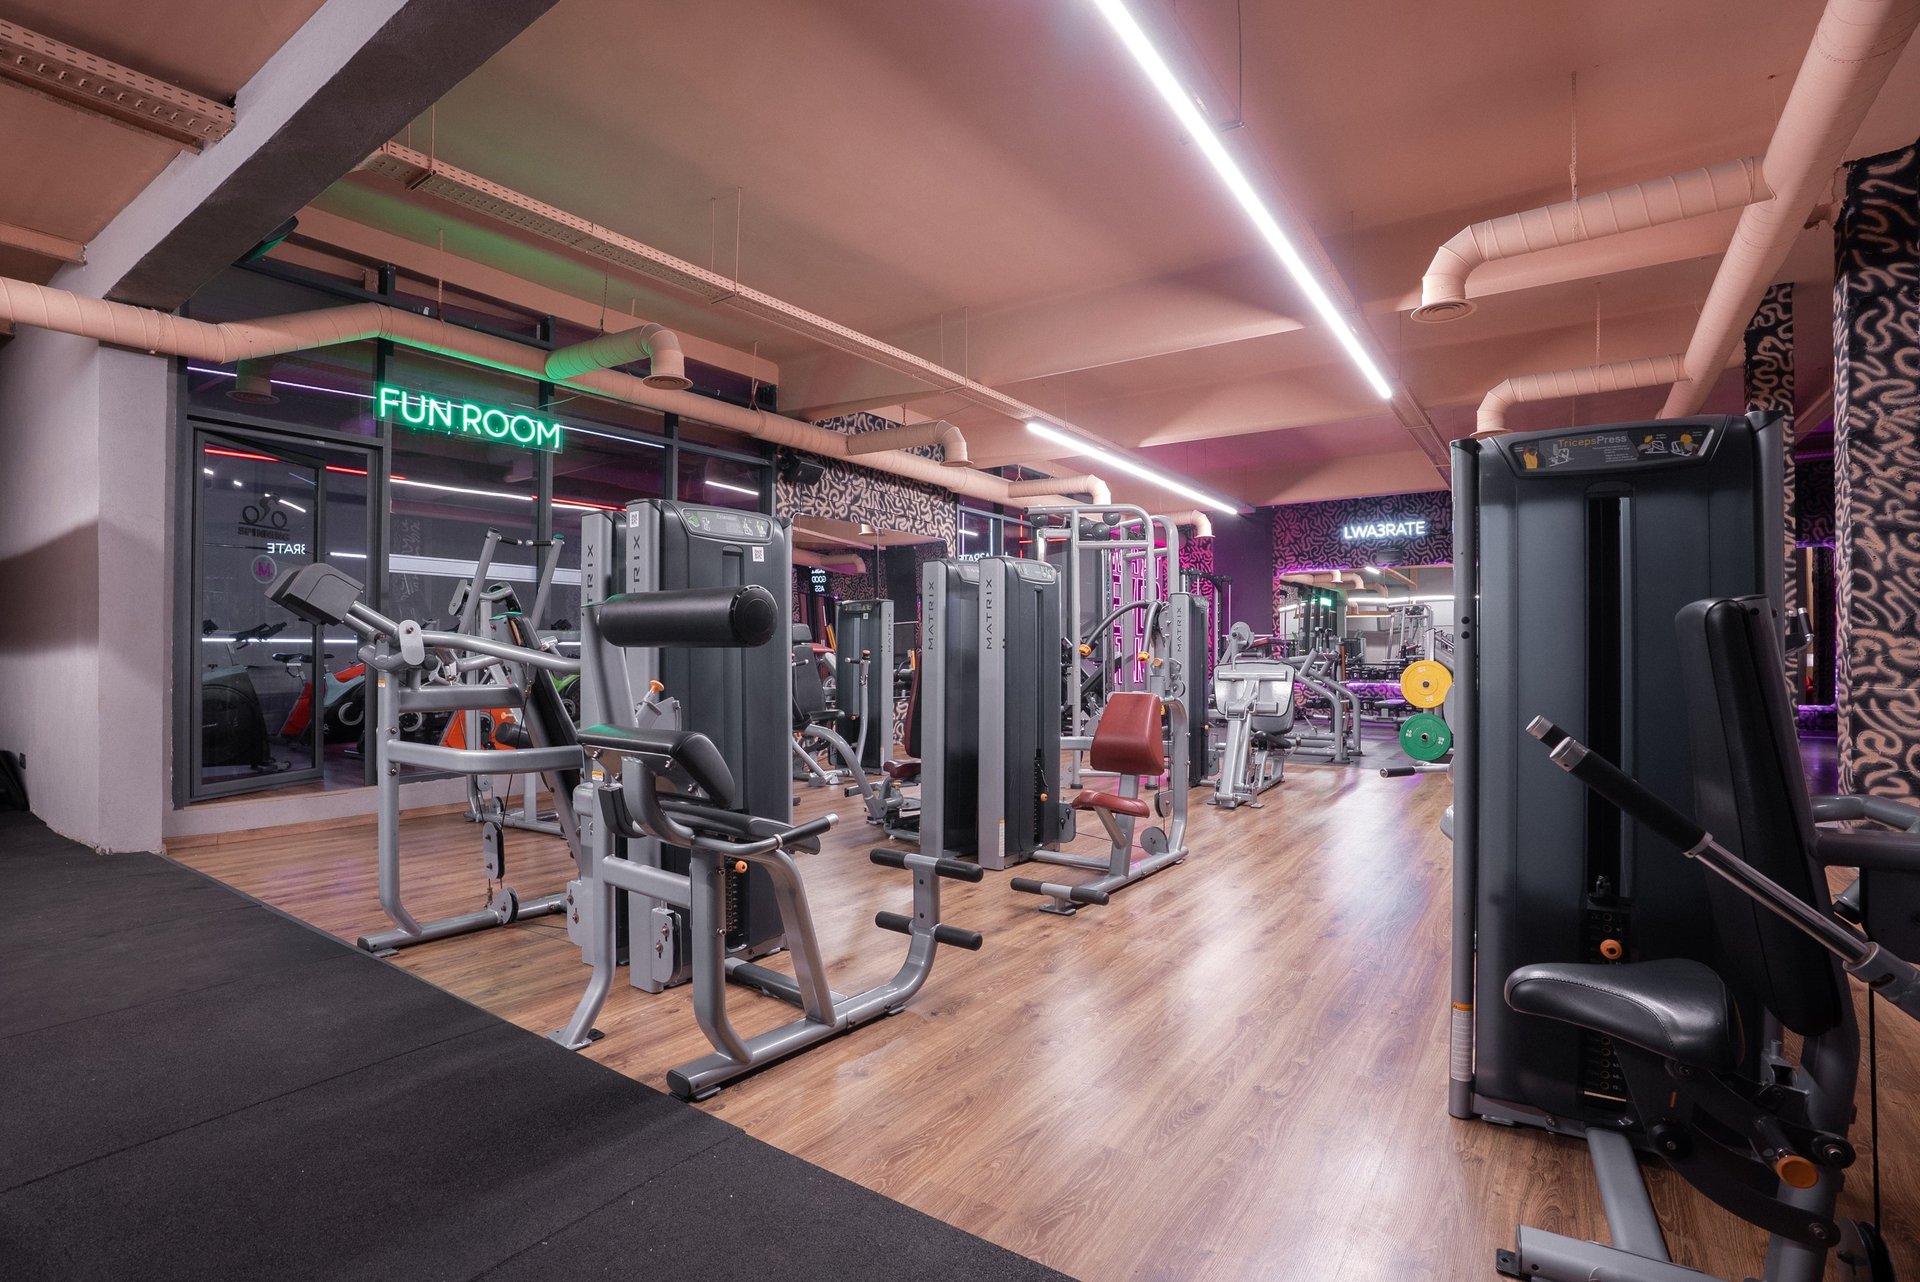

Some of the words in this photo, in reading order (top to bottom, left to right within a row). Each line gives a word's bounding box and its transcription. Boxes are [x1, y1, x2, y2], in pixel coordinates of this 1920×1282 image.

[379, 387, 452, 428] FUN
[462, 403, 561, 449] ROOM
[1557, 435, 1627, 448] TricepsPress
[1343, 520, 1426, 540] LWA3RATE
[985, 579, 993, 650] MATRIX
